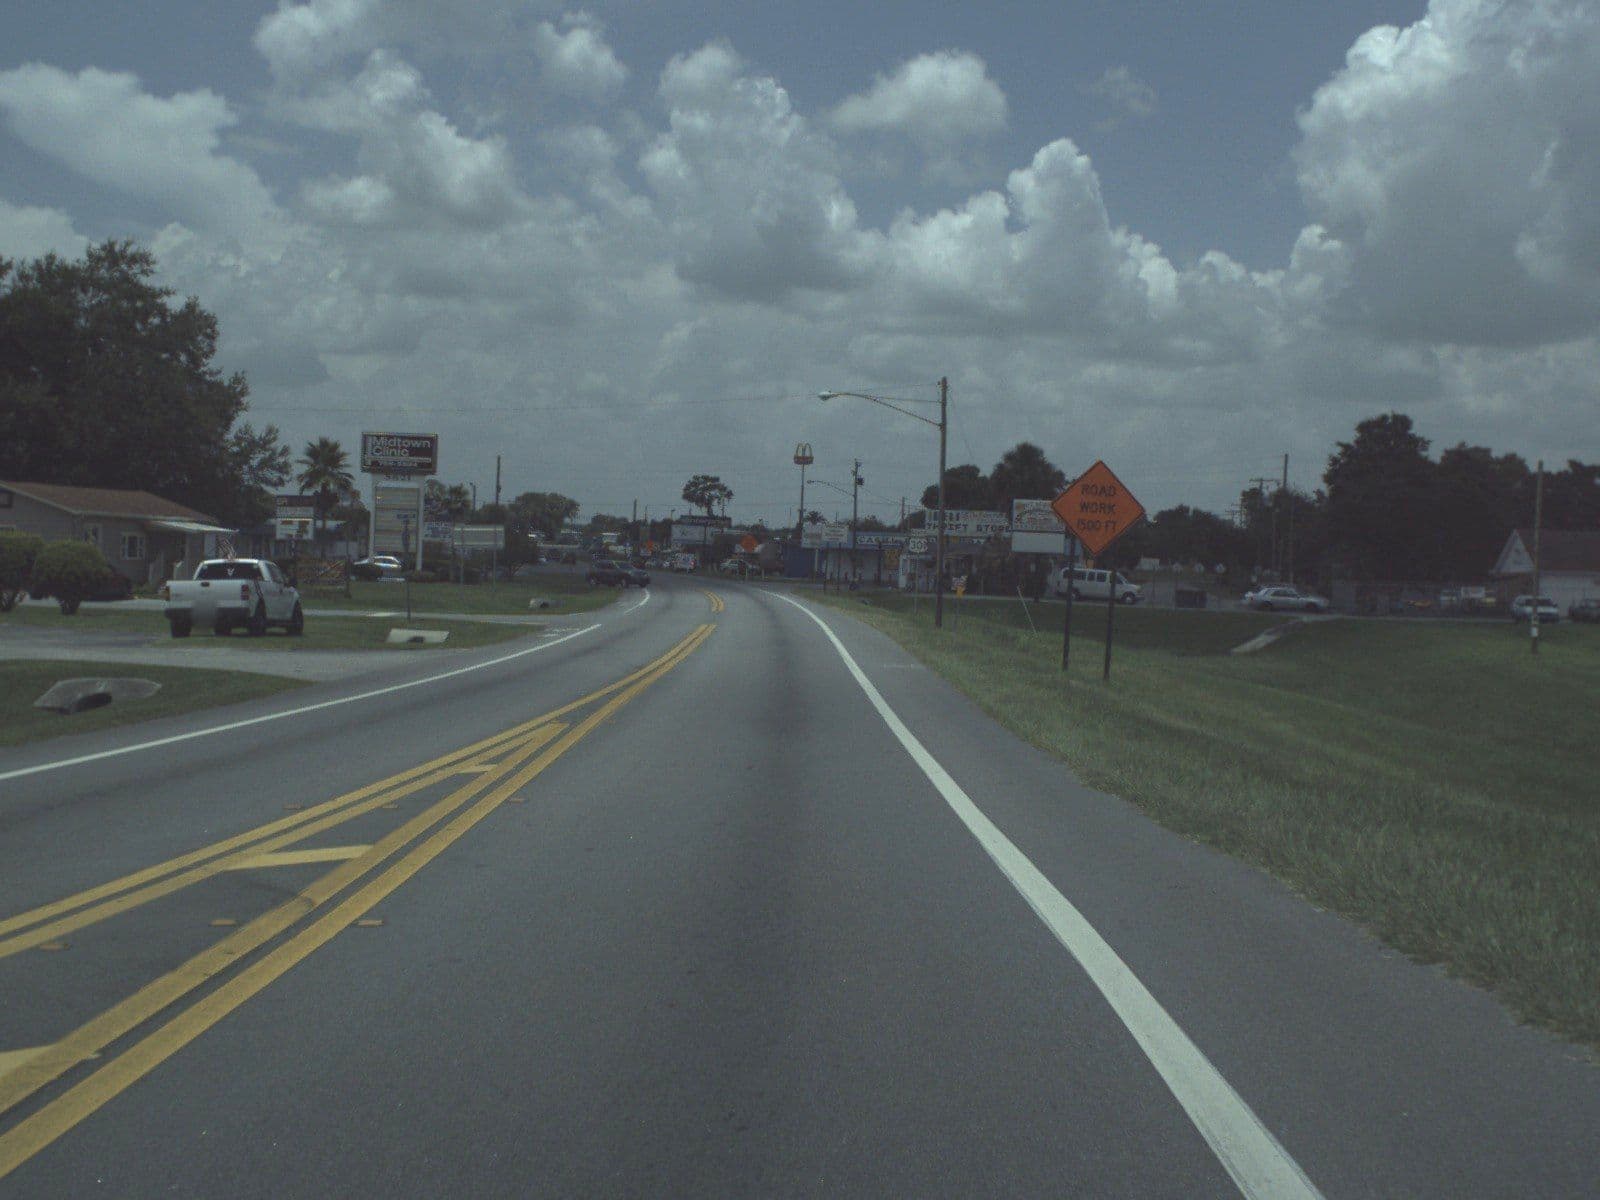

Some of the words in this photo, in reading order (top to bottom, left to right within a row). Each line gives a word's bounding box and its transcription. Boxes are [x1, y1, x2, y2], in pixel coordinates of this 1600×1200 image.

[372, 436, 431, 448] Midtown
[372, 446, 410, 456] Clinic
[1081, 483, 1116, 497] ROAD
[1080, 500, 1116, 514] WORK
[1077, 518, 1101, 532] 1500
[1105, 520, 1117, 534] FT
